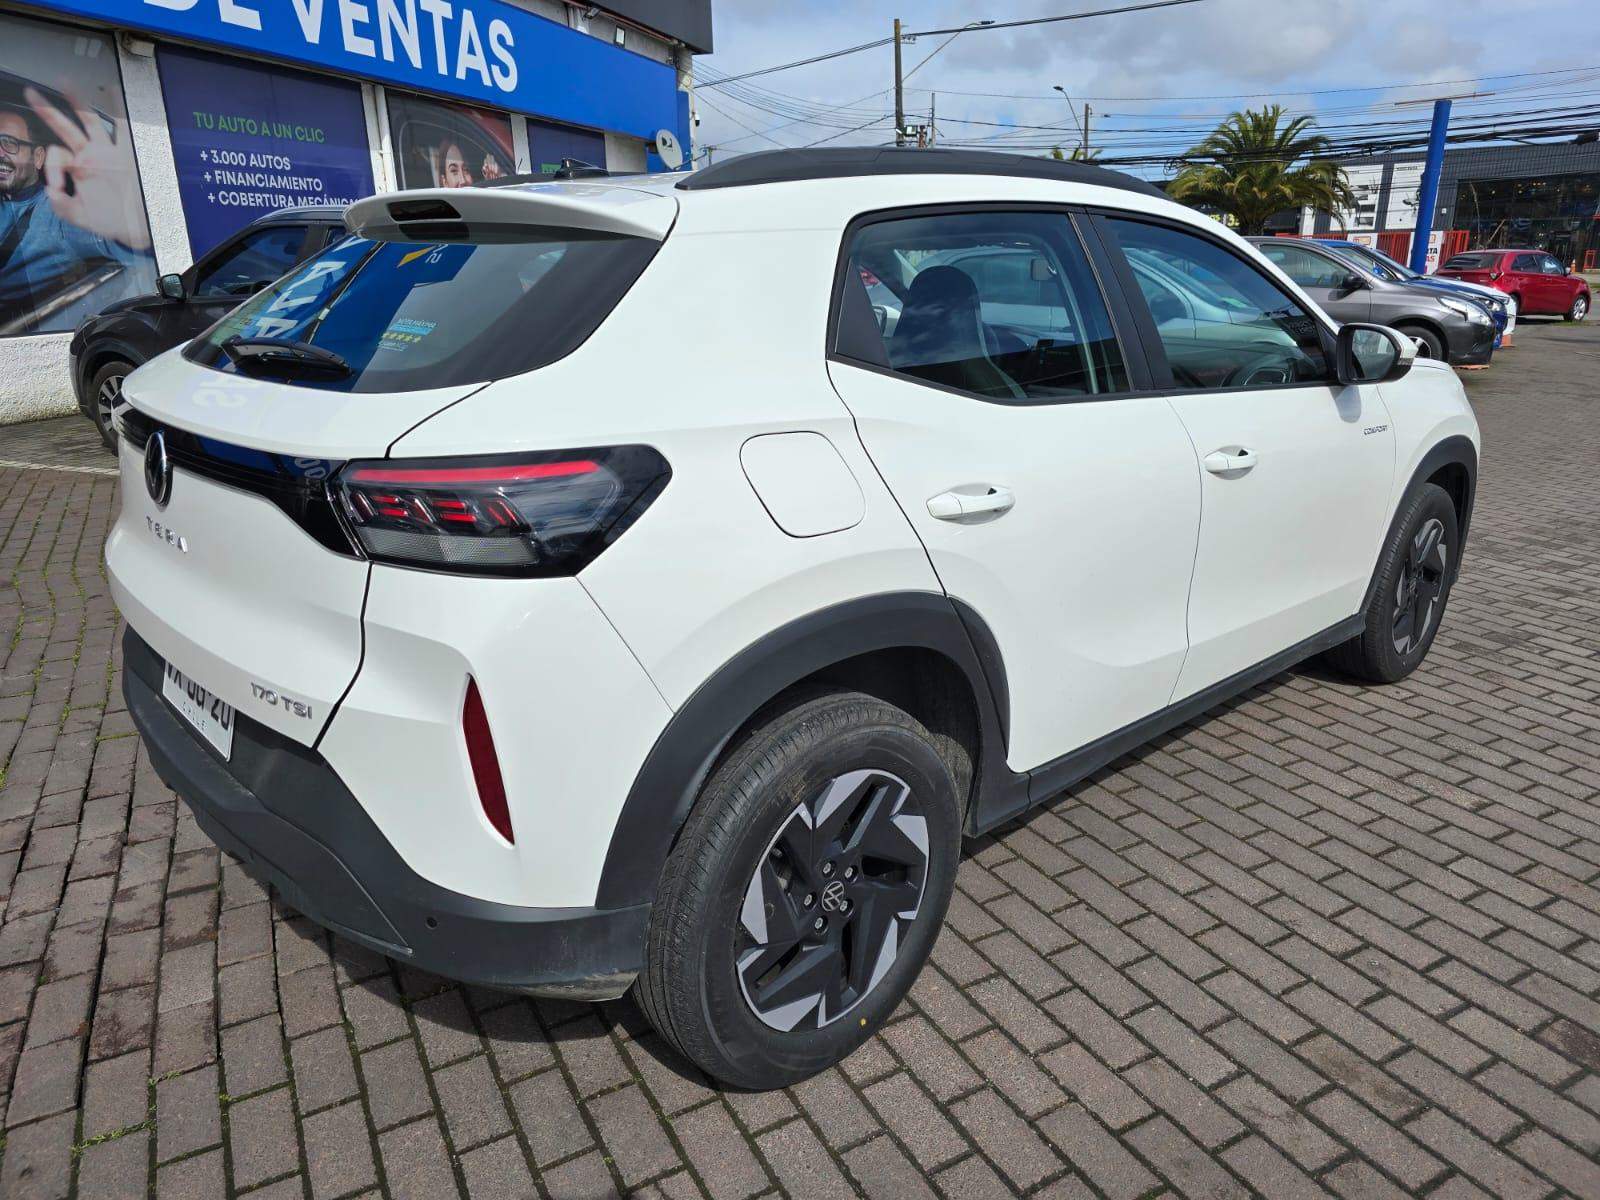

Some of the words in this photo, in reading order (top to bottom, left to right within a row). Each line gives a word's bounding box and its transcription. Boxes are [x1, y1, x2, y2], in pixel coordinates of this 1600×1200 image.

[292, 0, 518, 93] VENTAS
[193, 111, 214, 129] TU
[218, 115, 257, 135] AUTO
[261, 121, 271, 137] A
[273, 123, 293, 139] UN
[295, 125, 325, 143] CLIC
[210, 149, 247, 167] 3.000
[249, 153, 292, 171] AUTOS
[215, 170, 323, 192] FINANCIAMIENTO
[218, 190, 296, 209] COBERTURA
[145, 515, 188, 554] TERA
[250, 681, 279, 706] 170
[280, 695, 313, 720] TSI
